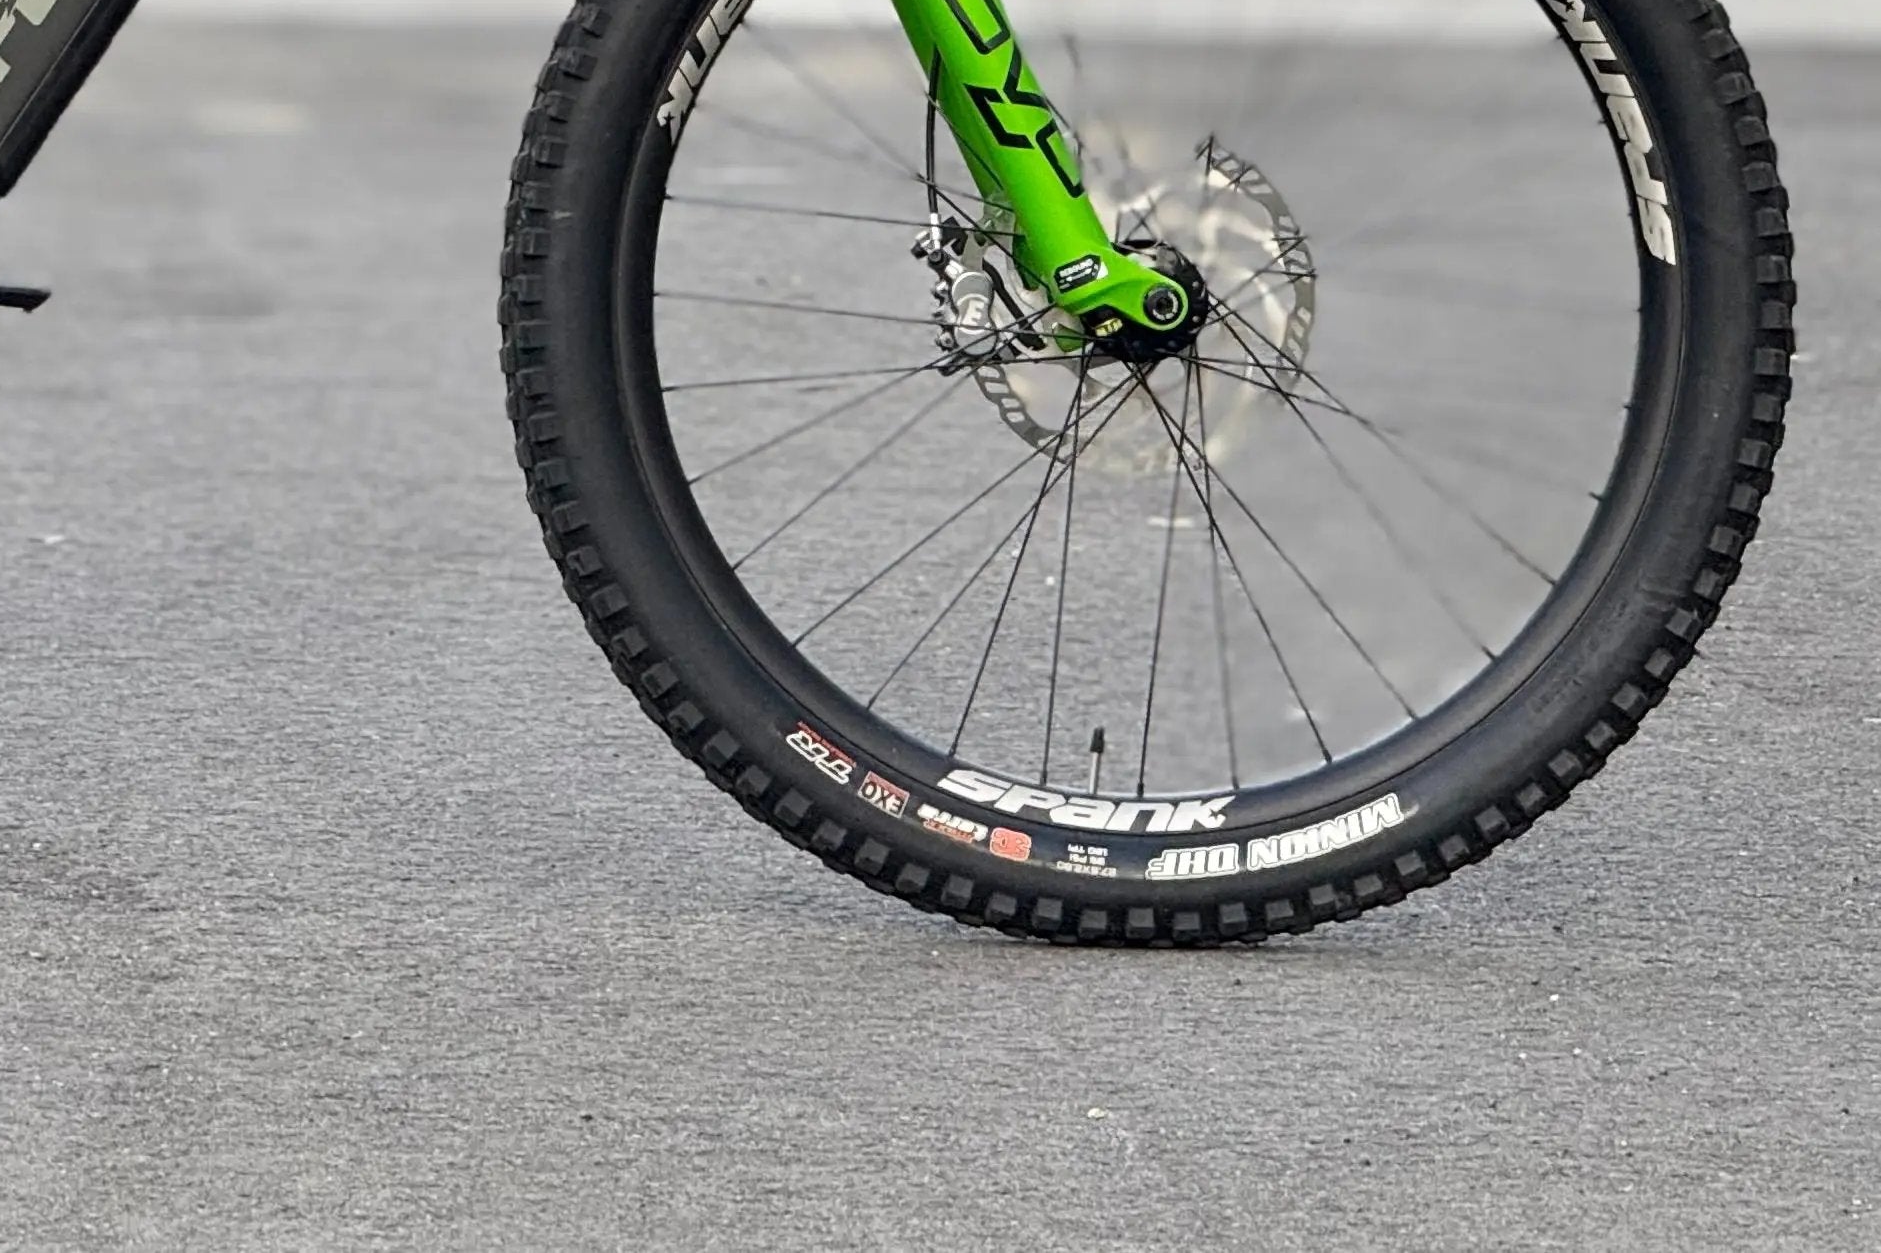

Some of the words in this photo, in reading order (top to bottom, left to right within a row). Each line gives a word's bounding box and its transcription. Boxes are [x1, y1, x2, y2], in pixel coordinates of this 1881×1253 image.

[786, 730, 854, 785] TR
[861, 780, 906, 817] EXO
[1246, 792, 1405, 872] MINION
[1144, 842, 1241, 880] DHF
